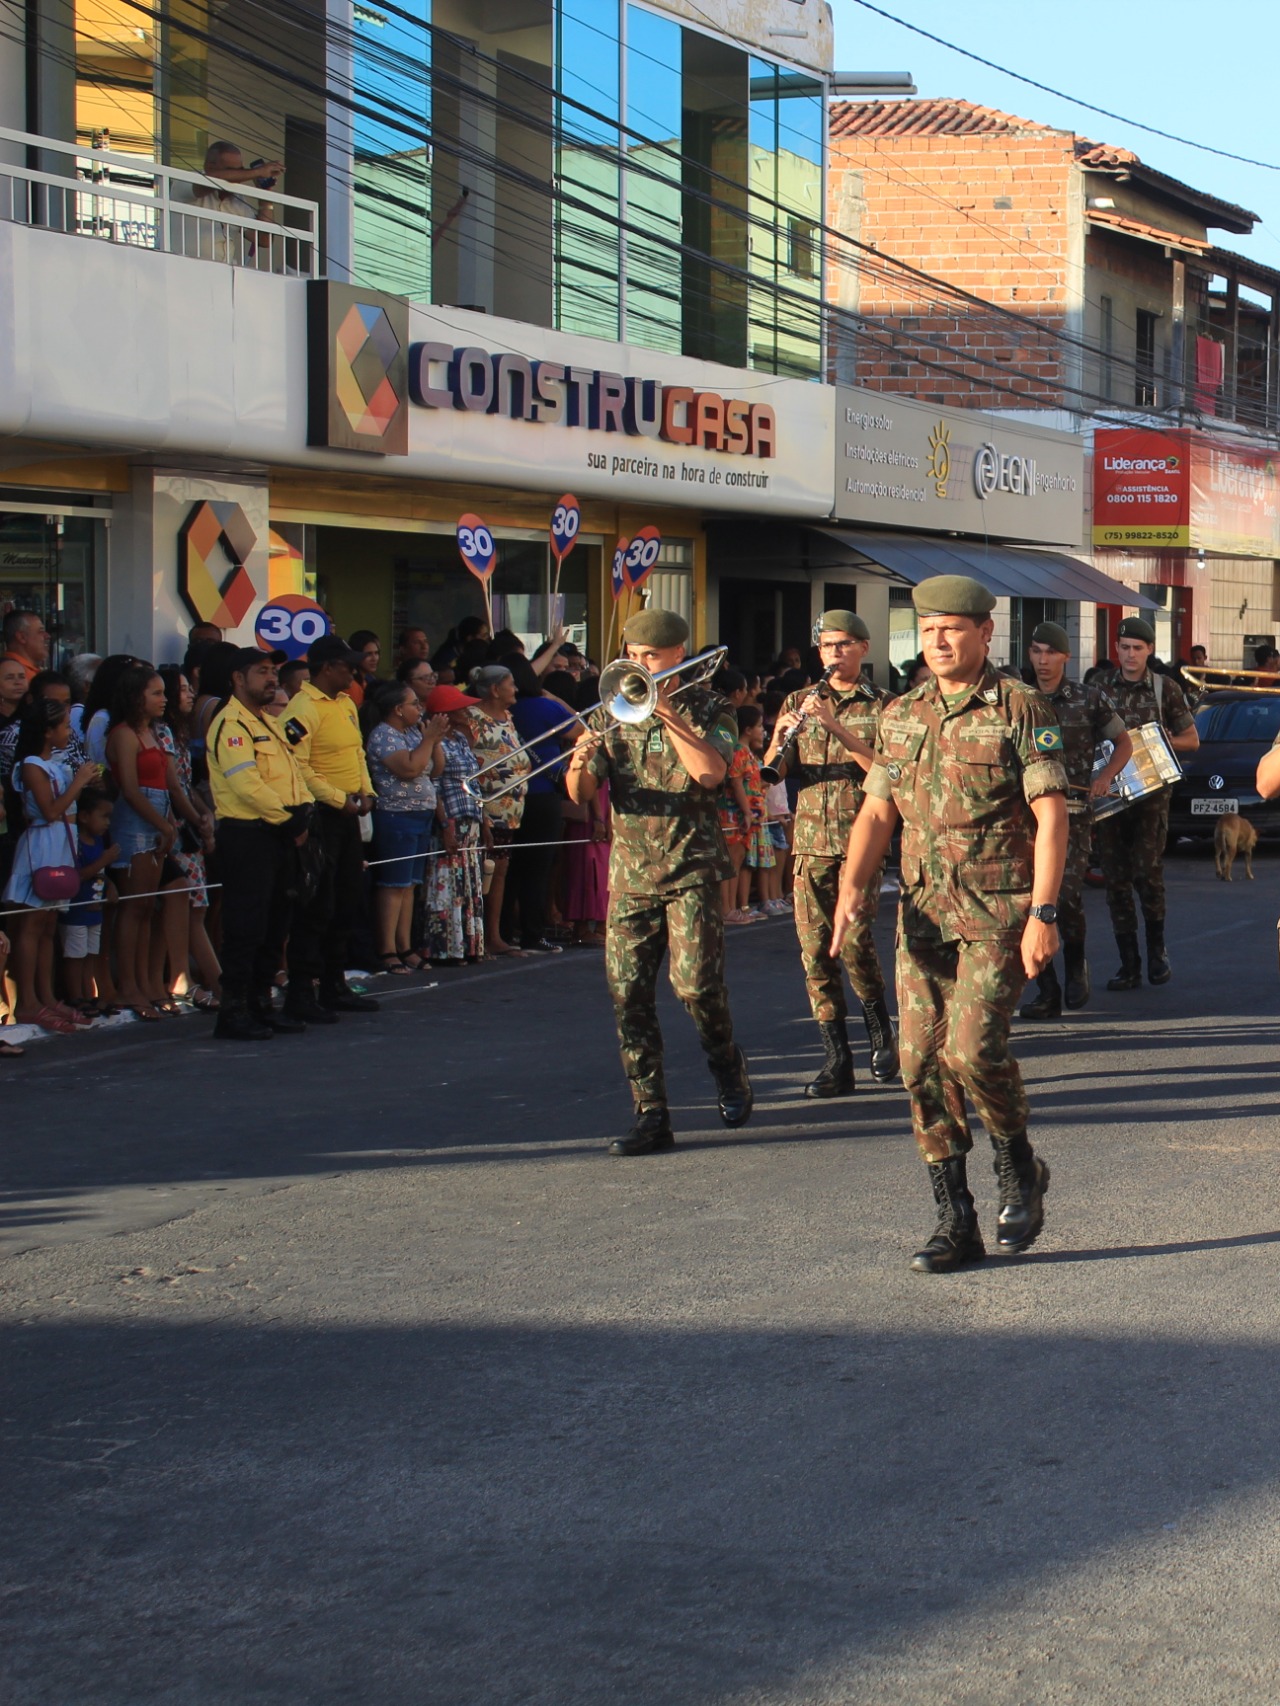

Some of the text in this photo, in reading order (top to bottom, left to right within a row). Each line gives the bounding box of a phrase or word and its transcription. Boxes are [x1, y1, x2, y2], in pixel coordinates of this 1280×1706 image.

[408, 341, 776, 459] CONSTRUCASA
[845, 407, 893, 430] Energia solar
[845, 442, 887, 464] Instalações
[1103, 456, 1166, 472] Liderança
[587, 452, 769, 488] sua parceira na hora de construir
[1035, 471, 1076, 492] engenharia
[845, 477, 927, 502] Automação residencial
[1107, 493, 1178, 504] 0800 115 1820
[1122, 484, 1169, 493] ASSISTÊNCIA
[552, 506, 579, 538] 30
[458, 528, 493, 557] 30
[1104, 531, 1179, 540] (75) 99822-8520
[625, 539, 659, 567] 30
[259, 608, 326, 645] 30
